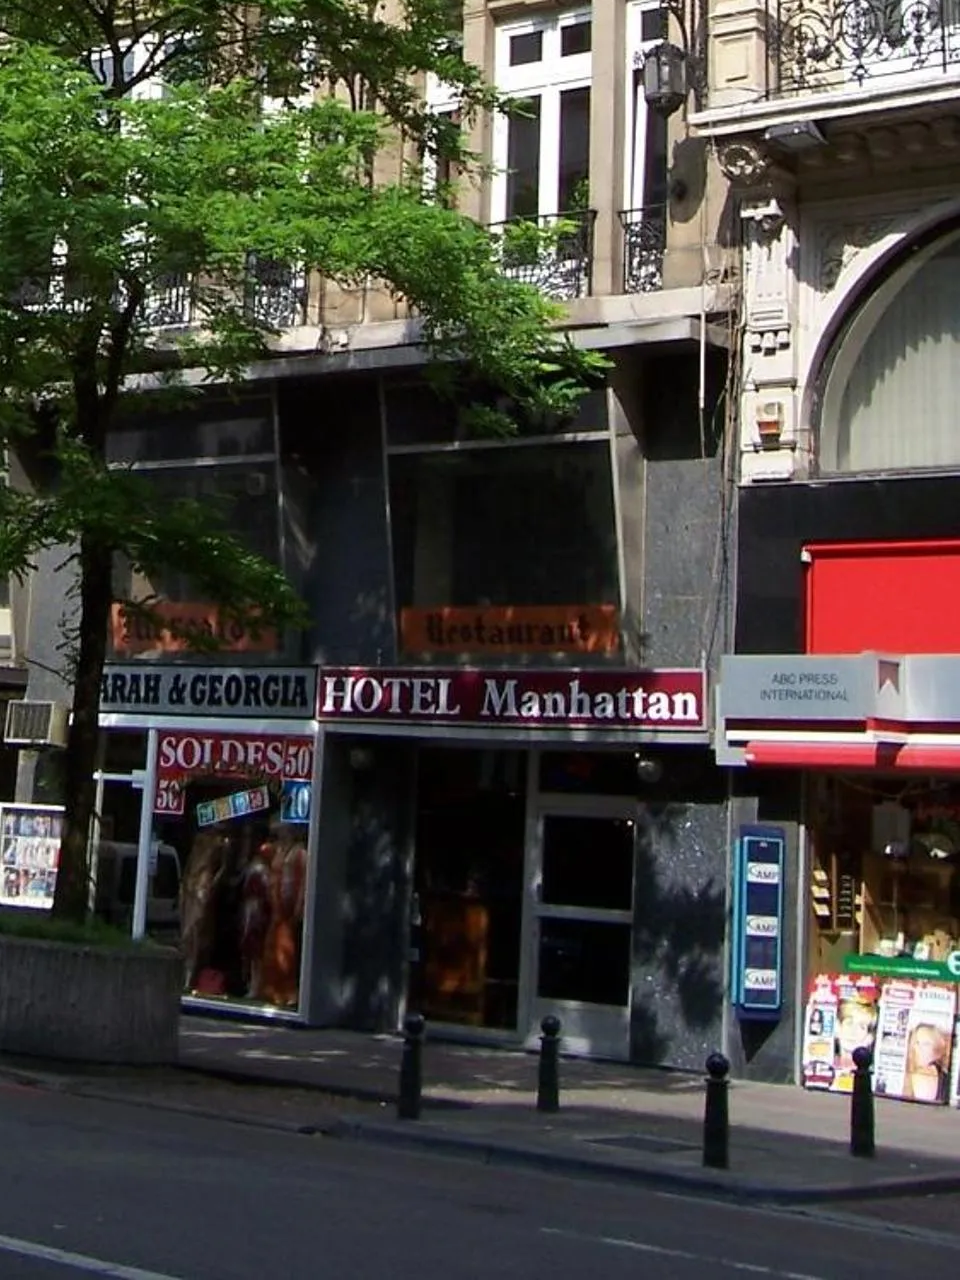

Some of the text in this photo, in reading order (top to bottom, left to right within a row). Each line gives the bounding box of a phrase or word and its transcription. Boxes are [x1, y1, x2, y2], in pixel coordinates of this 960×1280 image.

[168, 674, 186, 705] &
[190, 673, 308, 707] GEORGIA
[760, 687, 849, 702] INTERNATIONAL
[772, 672, 839, 686] ABC PRESS
[322, 676, 700, 721] HOTEL Manhattan
[160, 736, 284, 774] SOLDES
